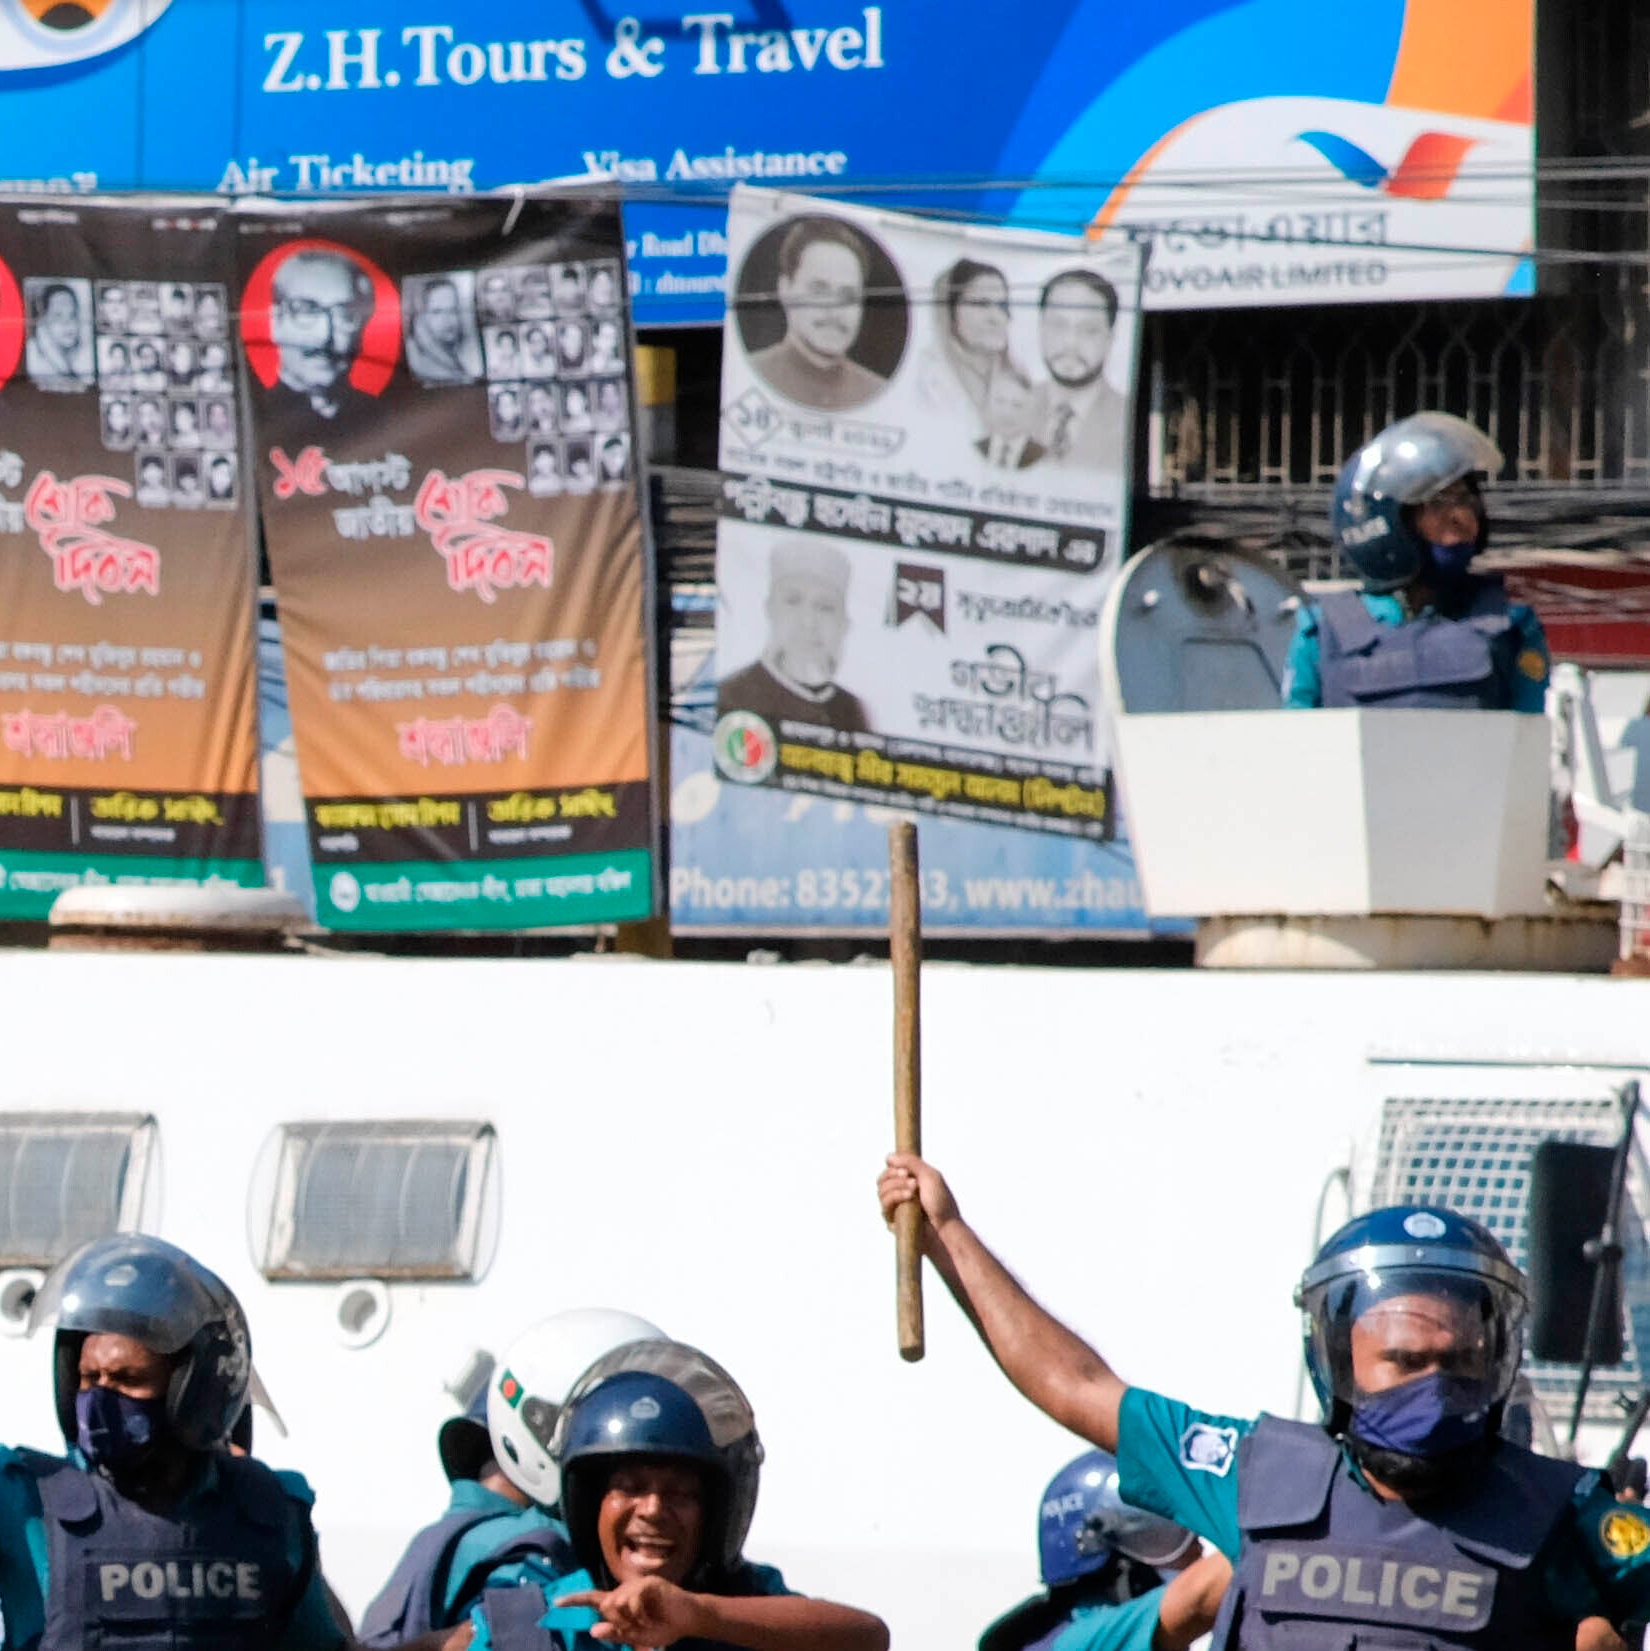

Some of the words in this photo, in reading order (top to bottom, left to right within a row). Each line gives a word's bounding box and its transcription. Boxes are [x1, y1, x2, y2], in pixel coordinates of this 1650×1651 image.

[605, 16, 666, 79] &
[683, 6, 885, 75] Travel
[217, 158, 279, 194] Air
[290, 150, 475, 194] Ticketing
[583, 150, 657, 182] Visa
[667, 147, 847, 181] Assistance
[1147, 265, 1268, 293] OVOAIR
[1271, 261, 1388, 288] LIMITED
[670, 867, 789, 908] Phone:
[100, 1560, 262, 1604] POLICE
[1260, 1551, 1487, 1619] POLICE
